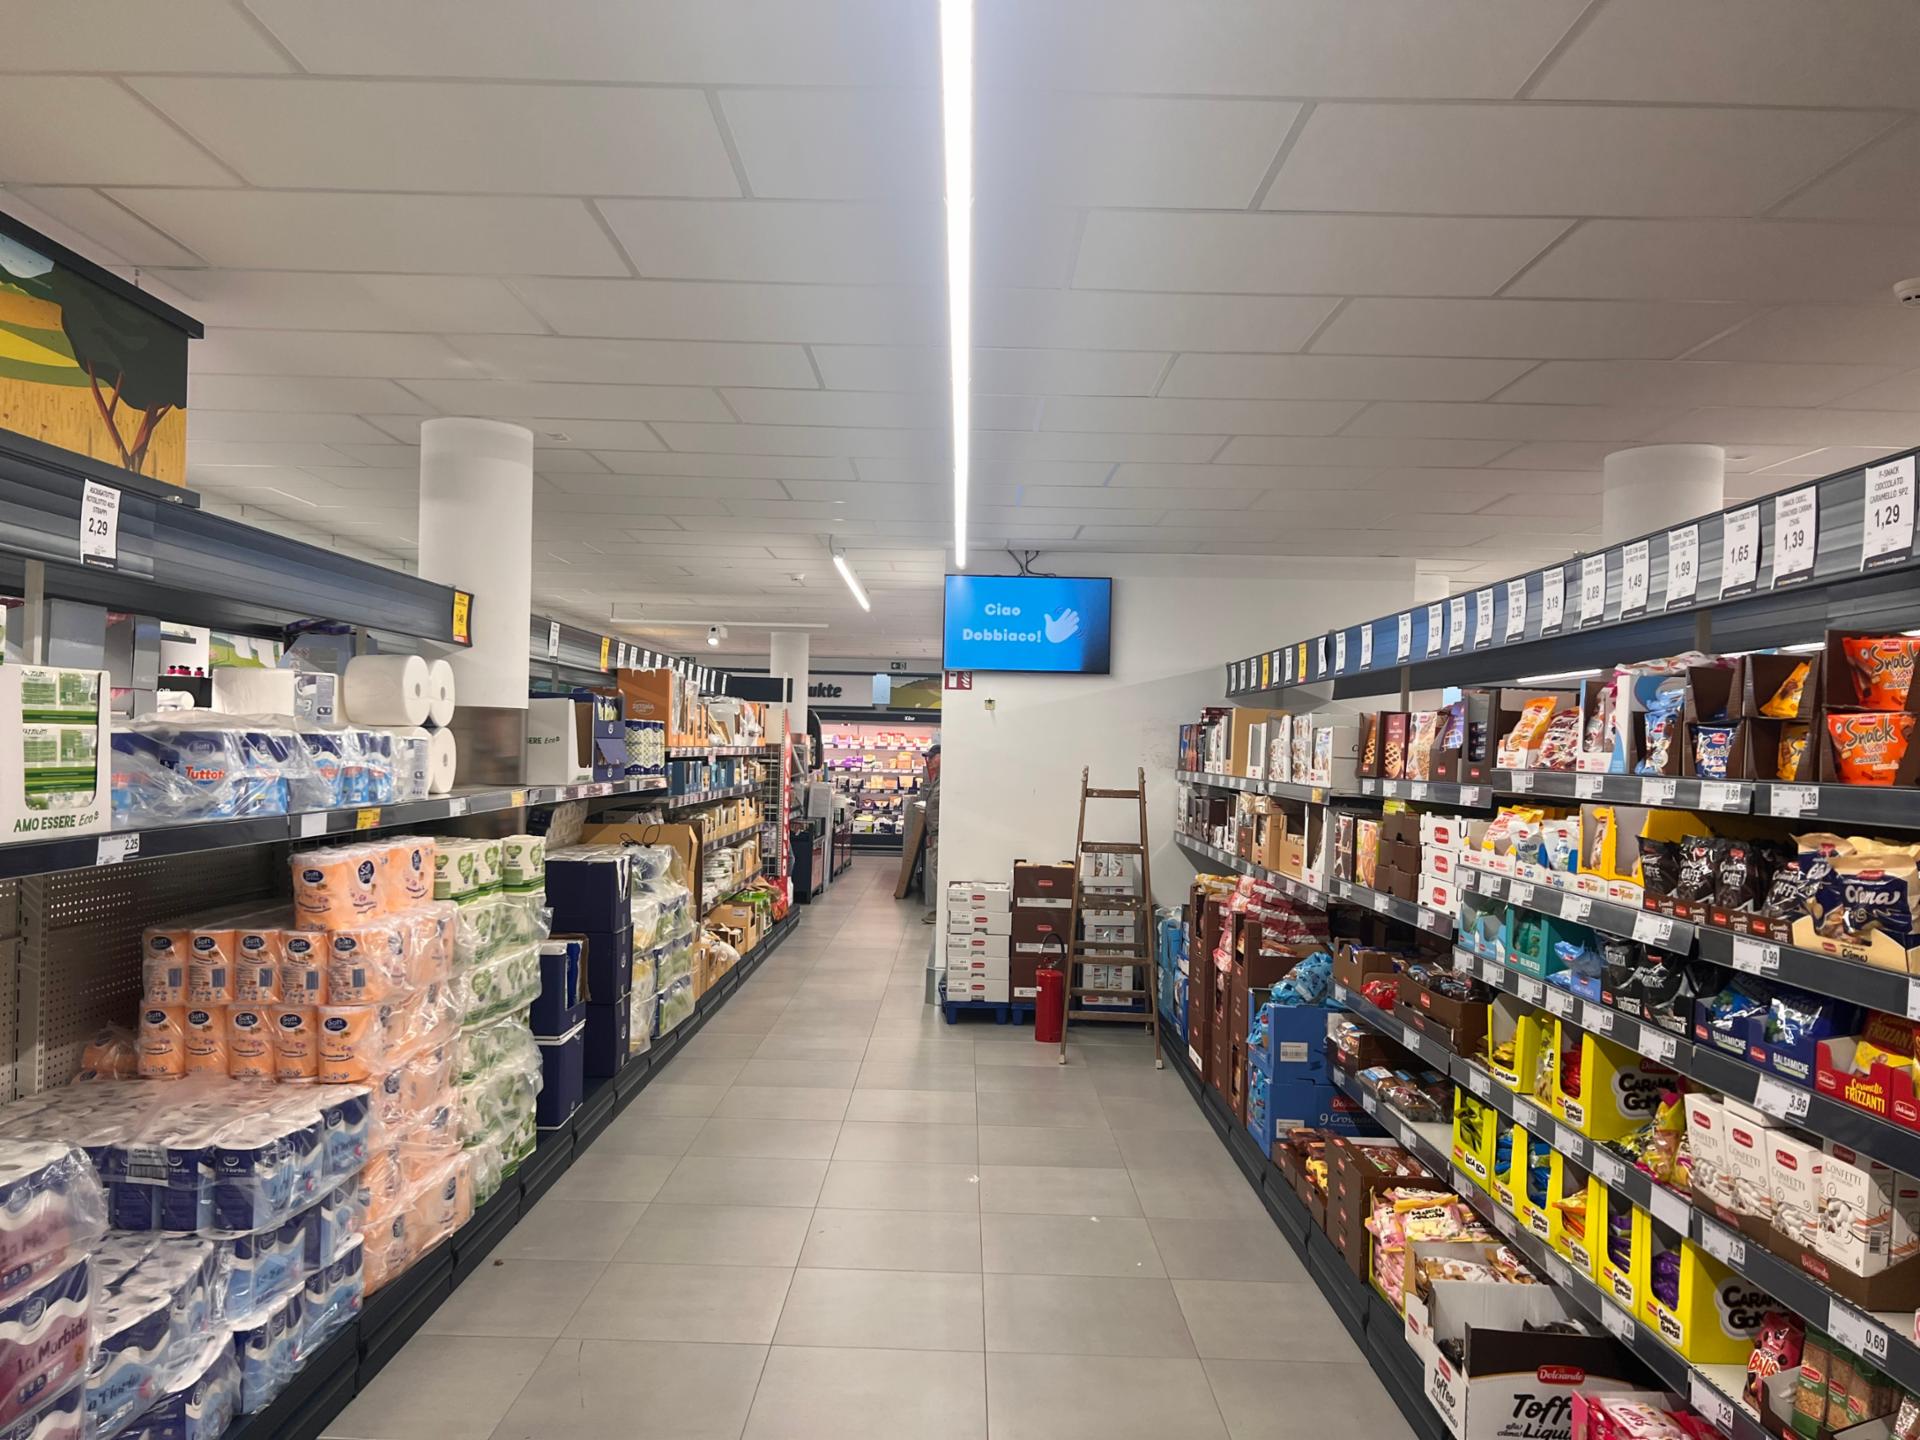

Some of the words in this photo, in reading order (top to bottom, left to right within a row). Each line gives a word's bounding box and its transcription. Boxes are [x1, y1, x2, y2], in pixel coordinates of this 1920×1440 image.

[89, 517, 108, 538] 2,29
[1874, 504, 1900, 533] 1,29
[1783, 529, 1804, 553] 1,39
[1731, 544, 1749, 565] 1,65
[1675, 561, 1691, 581] 1,99
[1629, 574, 1643, 591] 1,49
[984, 603, 1021, 617] Ciao
[962, 628, 1041, 644] Dobbiaco!
[808, 682, 841, 698] ukte
[1844, 717, 1898, 748] Snack
[1801, 791, 1817, 808] 1,39
[13, 818, 39, 833] AMO
[41, 815, 77, 830] ESSERE
[125, 839, 138, 851] 2,25
[1658, 923, 1671, 937] 1,39
[1762, 948, 1778, 967] 0,99
[1773, 1053, 1810, 1076] BALSAMICHE
[1789, 1094, 1806, 1114] 3,99
[1844, 1085, 1885, 1114] FRIZZANTI
[1319, 1113, 1329, 1126] 9
[1771, 1167, 1805, 1191] CONFETTI
[1825, 1161, 1862, 1186] CONFETTI
[1729, 1240, 1744, 1260] 1,79
[1865, 1329, 1885, 1353] 0,69
[1748, 1350, 1780, 1379] BALLS
[1433, 1367, 1456, 1408] Toffee
[1539, 1371, 1583, 1384] Dolciando
[1512, 1393, 1573, 1426] Toff
[1717, 1403, 1732, 1422] 1,29
